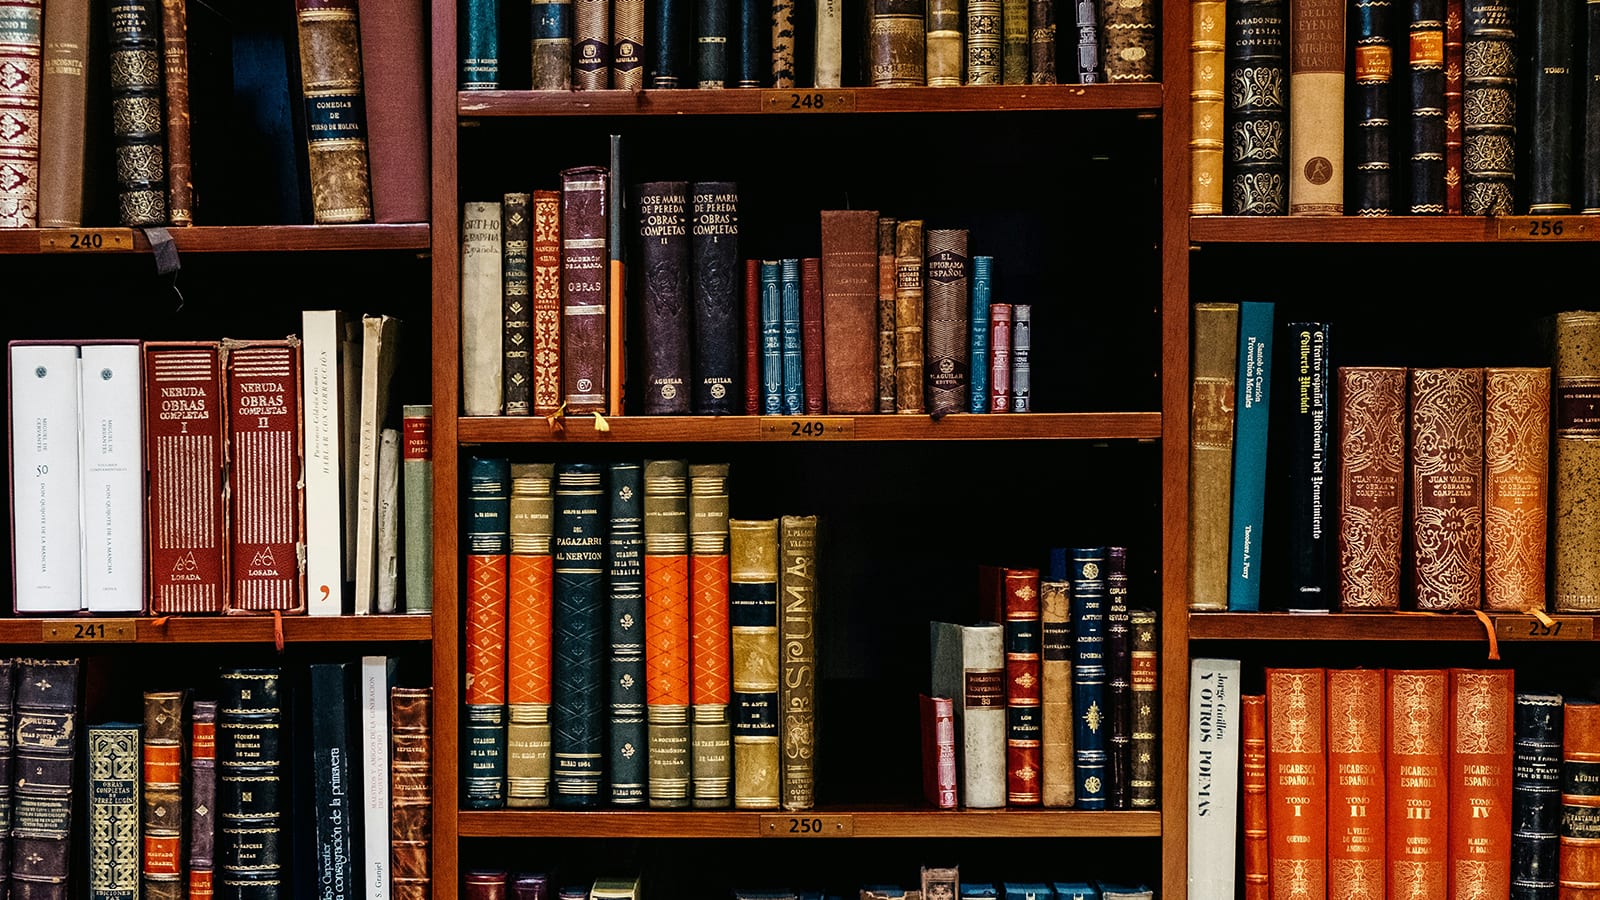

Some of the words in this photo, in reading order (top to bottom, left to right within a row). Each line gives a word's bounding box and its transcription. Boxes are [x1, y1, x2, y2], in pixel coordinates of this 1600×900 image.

[791, 94, 824, 109] 248
[640, 196, 660, 204] JOSE
[662, 195, 686, 204] MARIA
[692, 194, 713, 203] JOSE
[715, 194, 738, 203] MARIA
[642, 206, 652, 214] DE
[654, 205, 684, 214] PEREDA
[694, 204, 704, 212] DE
[706, 204, 736, 212] PEREDA
[648, 215, 678, 226] OBRAS
[700, 214, 730, 224] OBRAS
[640, 226, 686, 236] COMPLETAS
[692, 225, 738, 234] COMPLETAS
[1528, 220, 1564, 236] 256
[70, 234, 102, 250] 240
[929, 268, 964, 277] ESPAÑOL
[568, 282, 601, 292] OBRAS
[1246, 336, 1256, 377] Proverbios
[1256, 342, 1264, 367] Santob
[1313, 345, 1322, 371] teatro
[1256, 367, 1263, 375] de
[161, 388, 206, 397] NERUDA
[240, 383, 285, 392] NERUDA
[1245, 378, 1254, 408] Morales
[1255, 376, 1263, 402] Carrión
[162, 400, 206, 411] OBRAS
[240, 395, 284, 407] OBRAS
[160, 411, 210, 420] COMPLETAS
[238, 406, 288, 415] COMPLETAS
[181, 422, 188, 434] I
[791, 422, 824, 436] 249
[1312, 410, 1323, 451] Medieval
[36, 464, 48, 477] 50
[1313, 461, 1322, 473] del
[1311, 476, 1323, 539] Renacimiento
[557, 538, 602, 546] PAGAZARRI
[566, 552, 602, 560] NERVION
[1242, 562, 1250, 579] Perry
[74, 624, 104, 638] 241
[1216, 673, 1228, 700] Jorge
[1199, 688, 1213, 743] OTROS
[330, 748, 344, 795] primavera
[1279, 764, 1316, 774] PICARESCA
[1339, 764, 1375, 774] PICARESCA
[1401, 766, 1437, 776] PICARESCA
[1464, 765, 1500, 774] PICARESCA
[1198, 751, 1212, 817] POEMAS
[1280, 775, 1315, 785] ESPAÑOLA
[1340, 775, 1374, 785] ESPAÑOLA
[1401, 777, 1436, 787] ESPAÑOLA
[1464, 776, 1499, 786] ESPAÑOLA
[1294, 806, 1301, 816] I
[1351, 806, 1366, 816] II
[1407, 808, 1431, 819] III
[1472, 807, 1492, 818] IV
[330, 810, 342, 824] de
[790, 818, 822, 833] 250
[322, 843, 334, 884] Carpentier
[330, 827, 347, 892] consagración
[375, 862, 384, 888] Granjel
